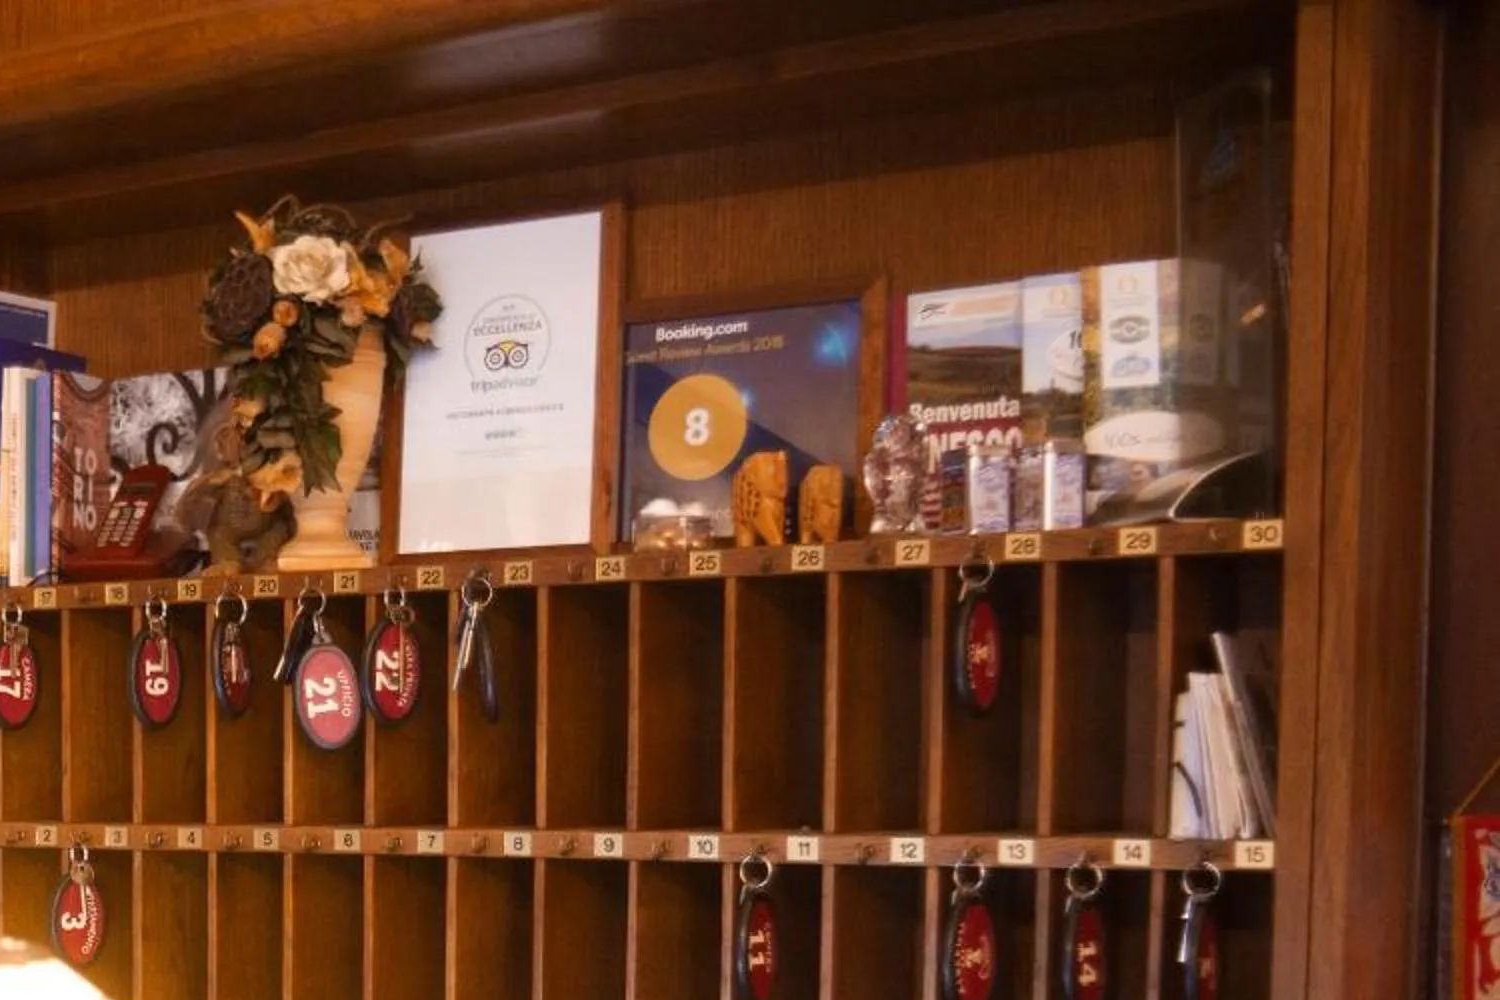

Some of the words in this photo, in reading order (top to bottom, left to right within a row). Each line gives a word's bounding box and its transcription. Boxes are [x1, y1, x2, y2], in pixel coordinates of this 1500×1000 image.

[656, 321, 748, 343] Booking.com
[909, 395, 1020, 423] Benvenuta
[684, 407, 710, 446] 8
[1249, 525, 1277, 542] 30
[1011, 537, 1035, 554] 28
[1126, 533, 1151, 550] 29
[797, 552, 819, 565] 26
[902, 544, 924, 560] 27
[600, 561, 621, 576] 24
[695, 556, 717, 571] 25
[421, 571, 440, 584] 22
[509, 565, 529, 580] 23
[259, 580, 276, 592] 20
[340, 576, 356, 589] 21
[183, 584, 197, 597] 19
[40, 591, 53, 606] 17
[145, 660, 169, 696] 19
[375, 650, 400, 692] 22
[304, 676, 340, 719] 21
[337, 669, 351, 718] UFFICIO
[43, 830, 52, 841] 2
[113, 831, 122, 843] 3
[186, 832, 196, 844] 4
[263, 833, 272, 846] 5
[343, 834, 352, 847] 6
[427, 835, 436, 848] 7
[513, 837, 522, 850] 8
[604, 839, 614, 852] 9
[697, 840, 714, 854] 10
[798, 842, 811, 856] 11
[900, 843, 917, 858] 12
[1007, 844, 1026, 860] 13
[1123, 845, 1141, 860] 14
[1245, 847, 1265, 863] 15
[61, 911, 86, 931] 3
[749, 930, 765, 972] 11
[1077, 942, 1099, 987] 14
